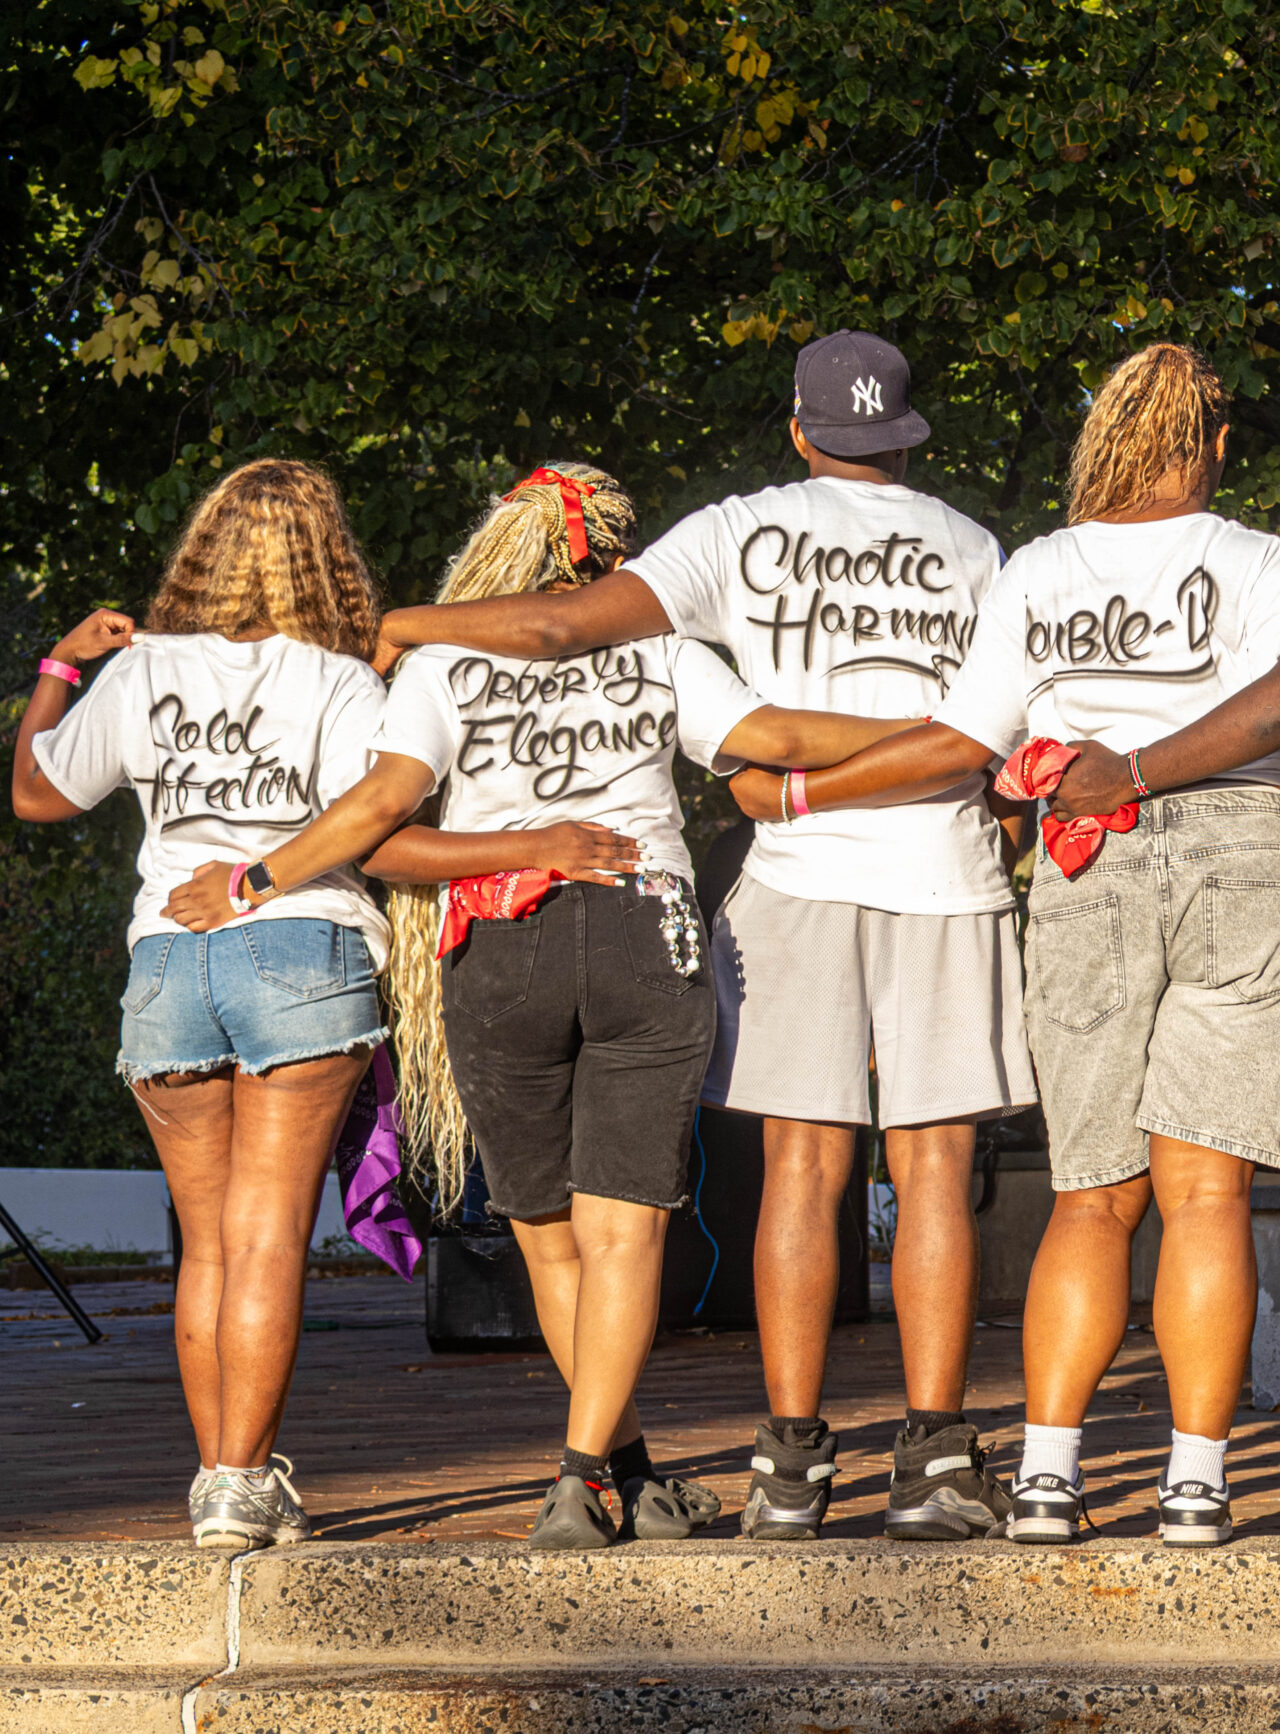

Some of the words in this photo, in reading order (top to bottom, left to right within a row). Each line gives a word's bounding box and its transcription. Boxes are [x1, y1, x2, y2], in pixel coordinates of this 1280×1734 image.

[850, 375, 884, 416] NY
[740, 525, 953, 594] Chaotic
[149, 693, 281, 755] Cold
[1036, 1475, 1060, 1488] NIKE
[1180, 1483, 1204, 1495] NIKE
